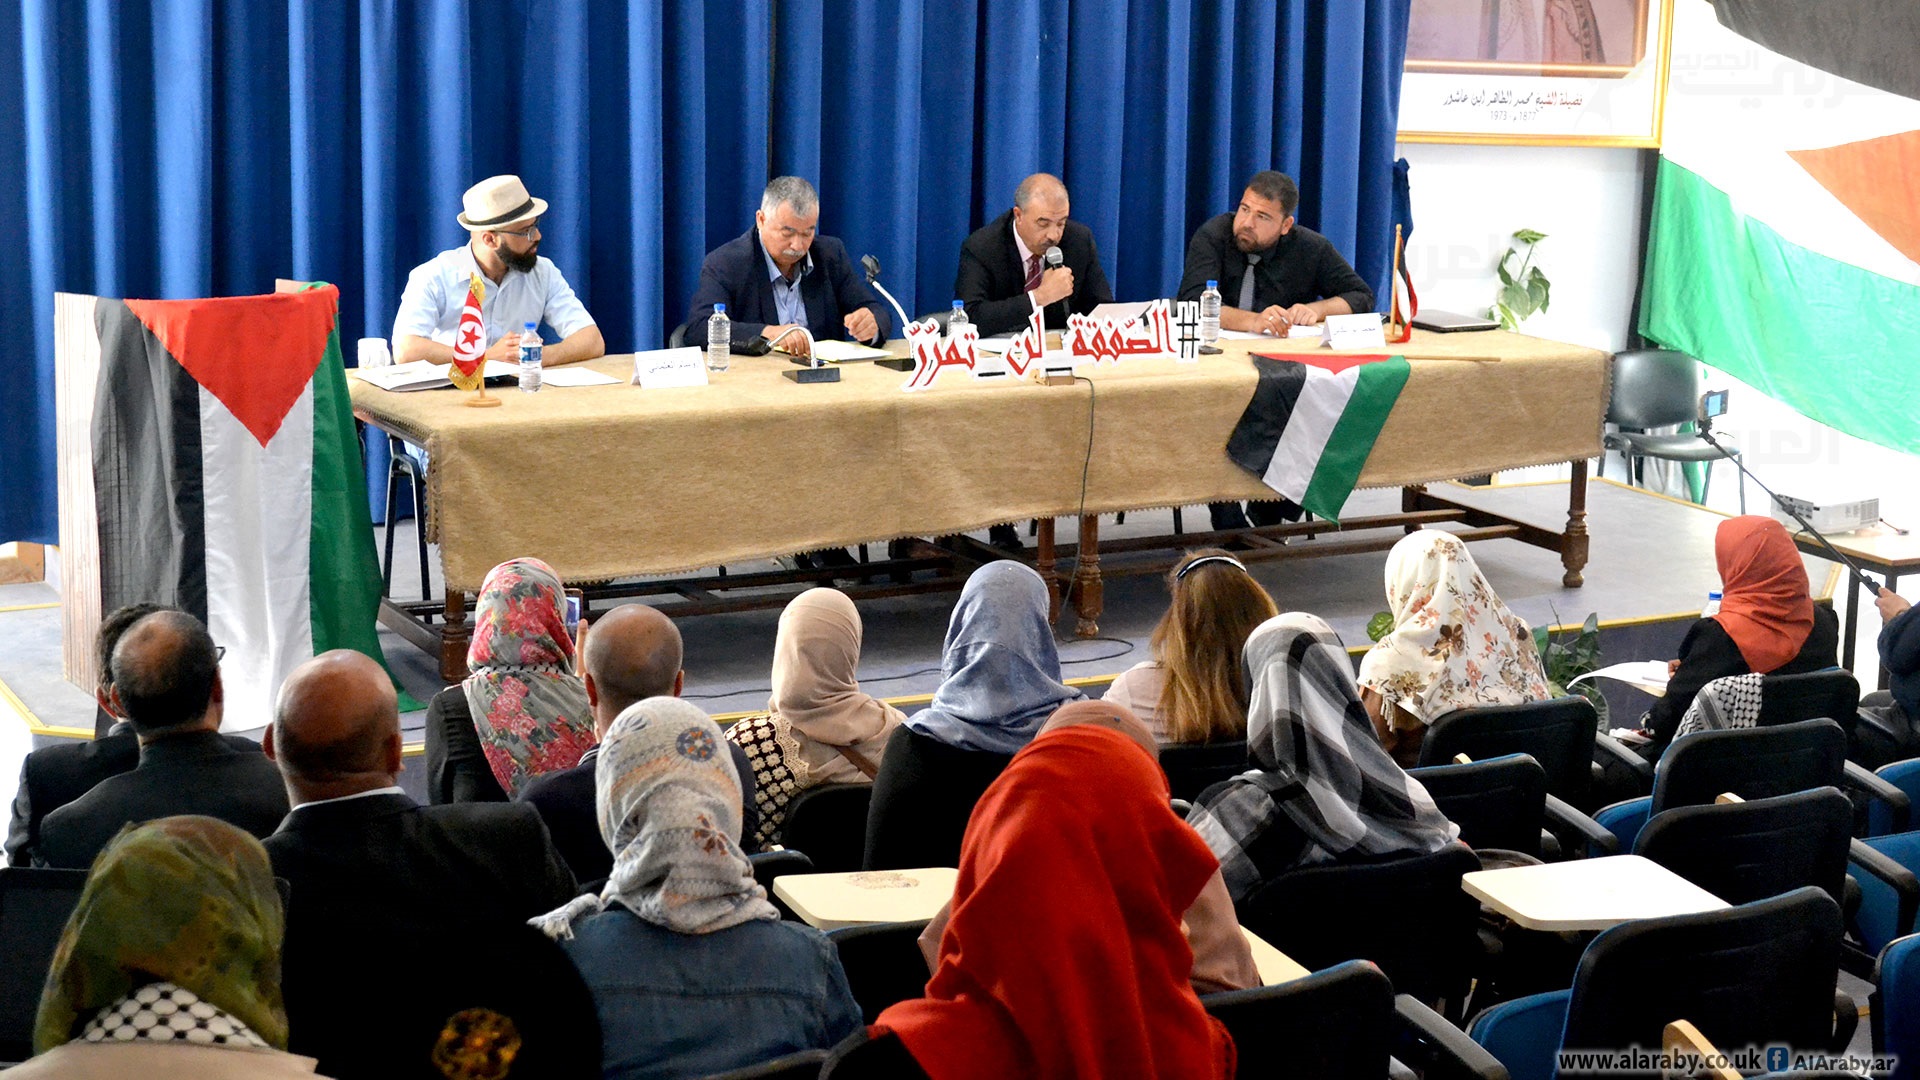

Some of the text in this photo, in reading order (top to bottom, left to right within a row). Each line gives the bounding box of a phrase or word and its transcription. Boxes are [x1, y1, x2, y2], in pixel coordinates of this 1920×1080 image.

[1485, 89, 1513, 107] الطاهر
[1512, 91, 1535, 108] محمد
[1534, 90, 1558, 112] الشيخ
[1489, 110, 1507, 121] 1973
